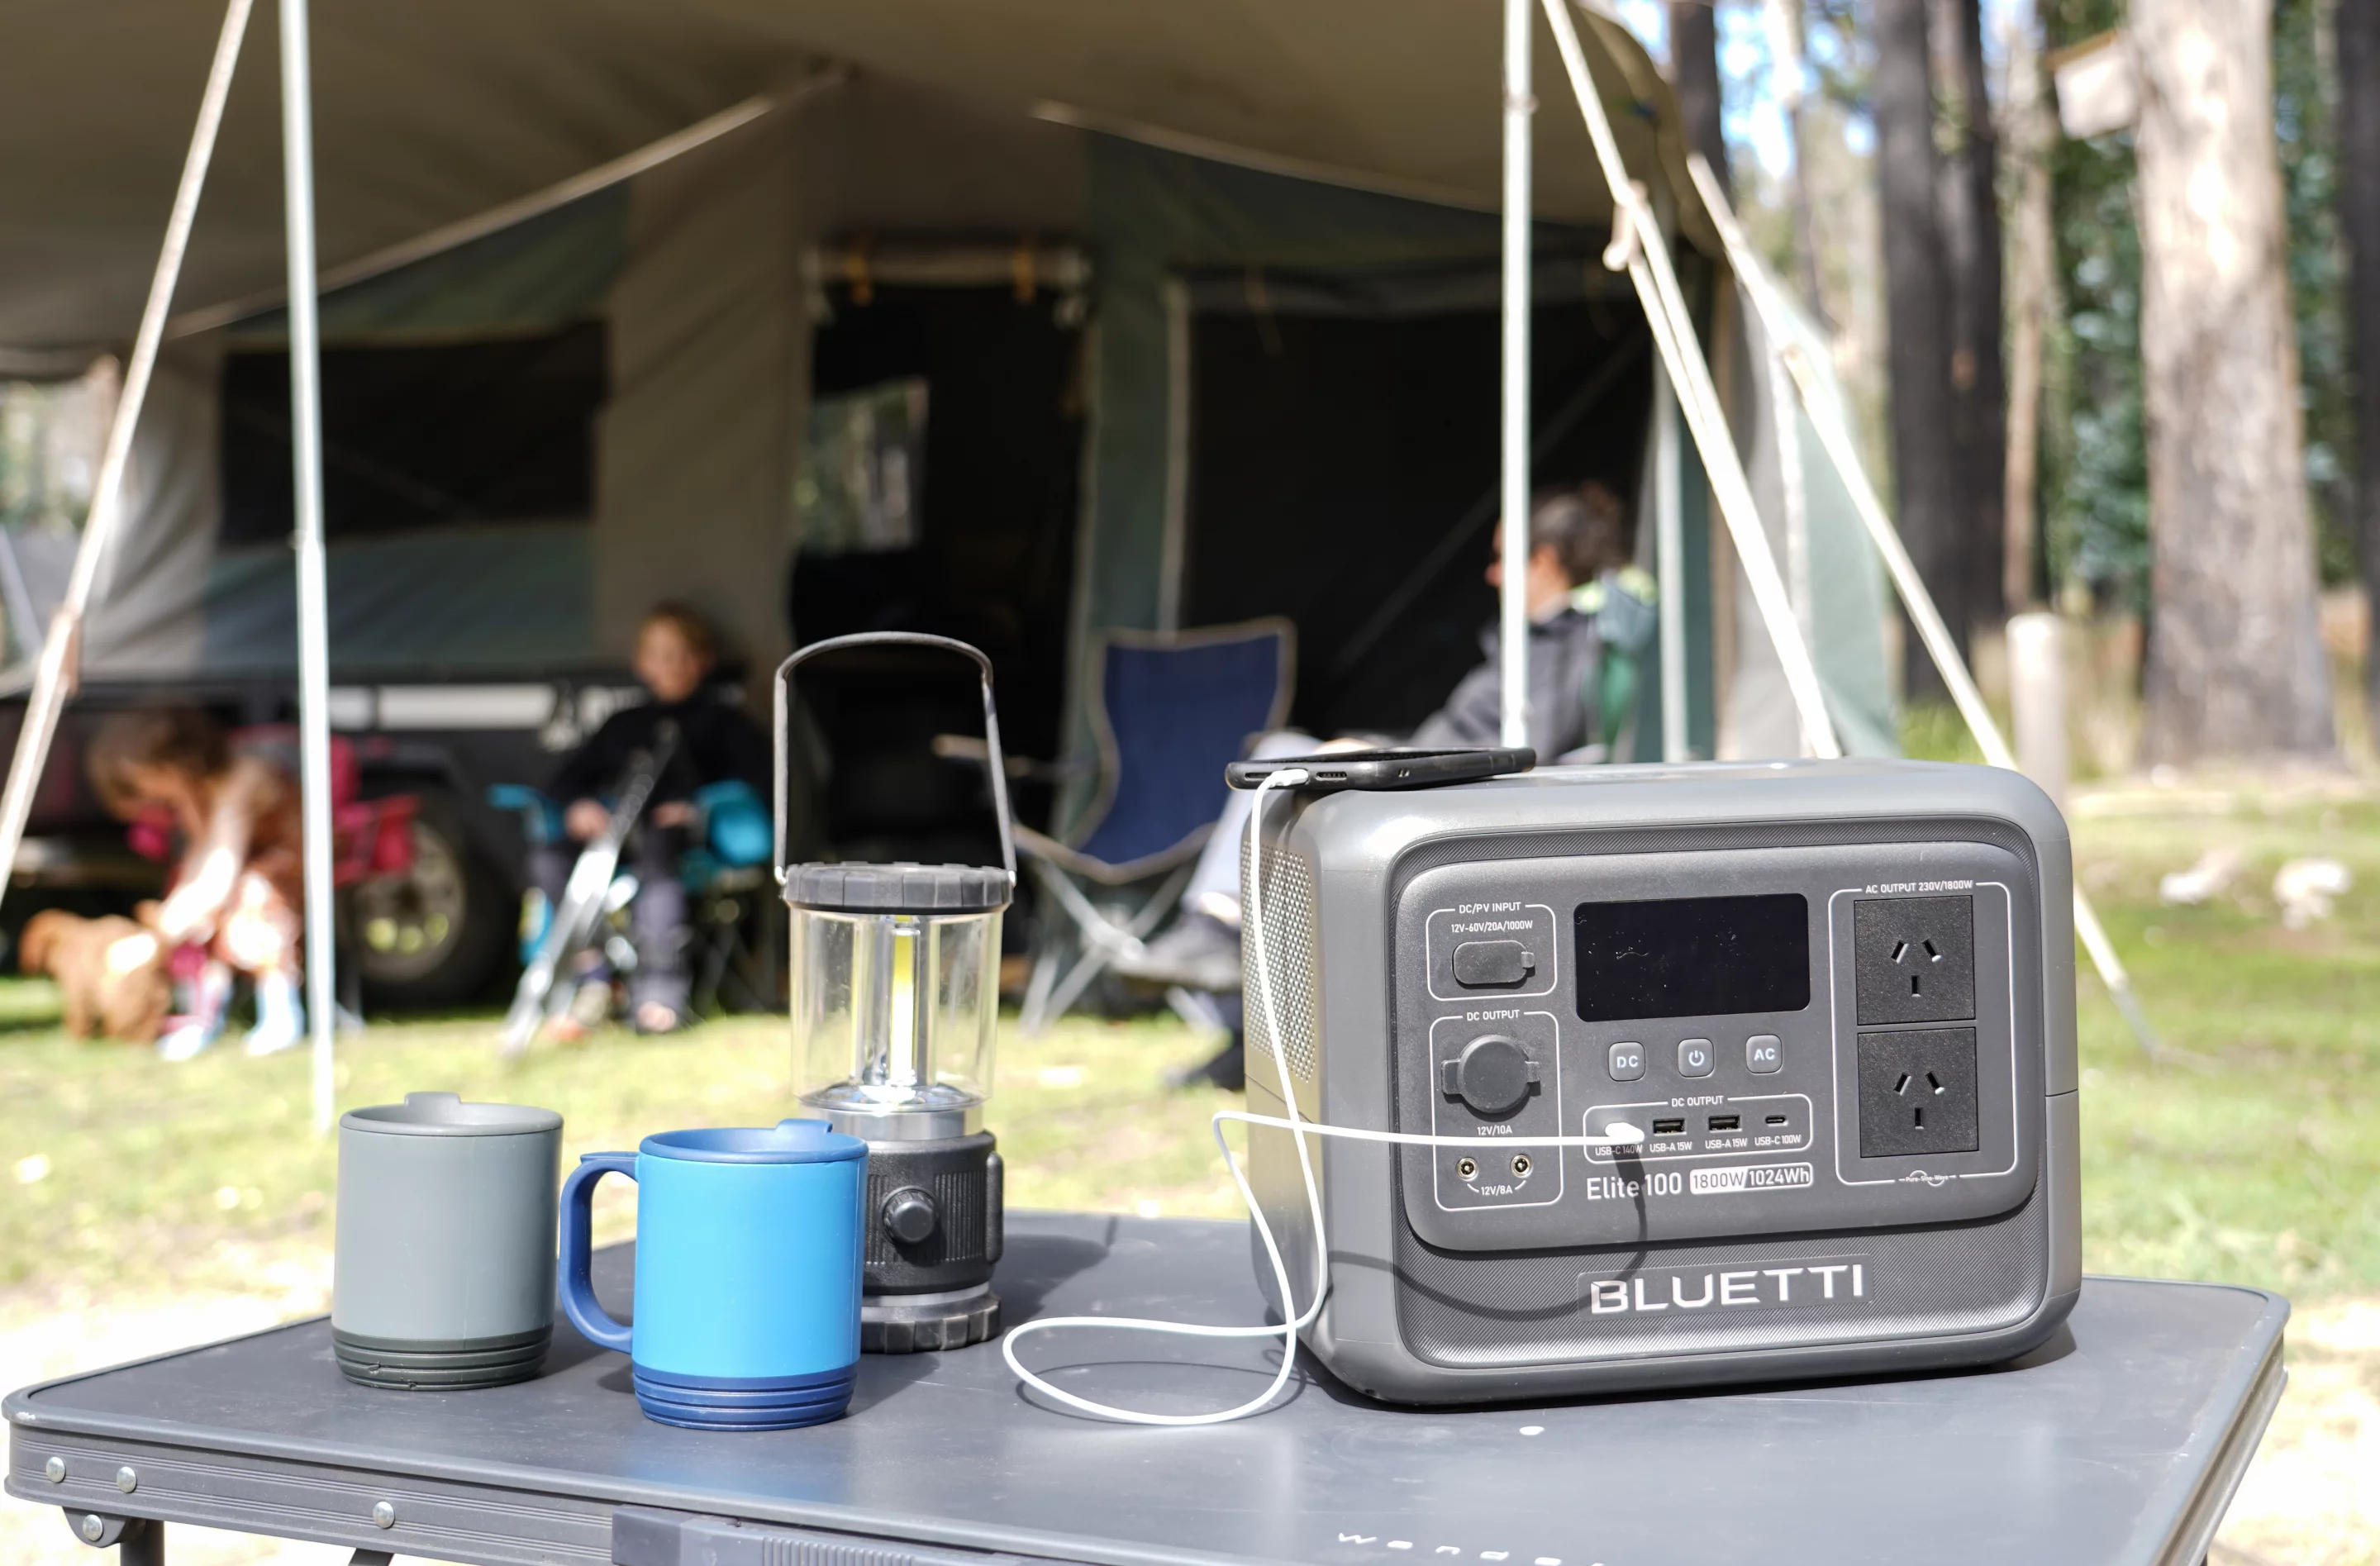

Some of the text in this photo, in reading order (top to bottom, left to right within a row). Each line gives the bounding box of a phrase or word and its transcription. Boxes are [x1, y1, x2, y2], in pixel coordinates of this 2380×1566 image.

[1865, 879, 1973, 894] AC OUTPUT 230V/1800W
[1459, 902, 1521, 915] DC/PV INPUT
[1450, 920, 1533, 933] 12V-60V/20A/1000W
[1466, 1009, 1520, 1021] DC OUTPUT
[1754, 1048, 1776, 1061] AC
[1616, 1055, 1639, 1069] DC
[1671, 1095, 1724, 1108] DC OUTPUT
[1477, 1125, 1513, 1136] 12V/10A
[1705, 1138, 1748, 1150] USB-A 15W
[1754, 1134, 1802, 1146] USB-C 100W
[1595, 1144, 1643, 1156] USB-C 140W
[1649, 1141, 1692, 1153] USB-A 15W
[1692, 1167, 1810, 1189] 1800W 1024Wh
[1480, 1184, 1513, 1197] 12V/8A
[1587, 1172, 1682, 1200] Elite 100
[1590, 1264, 1864, 1314] BLUETTI
